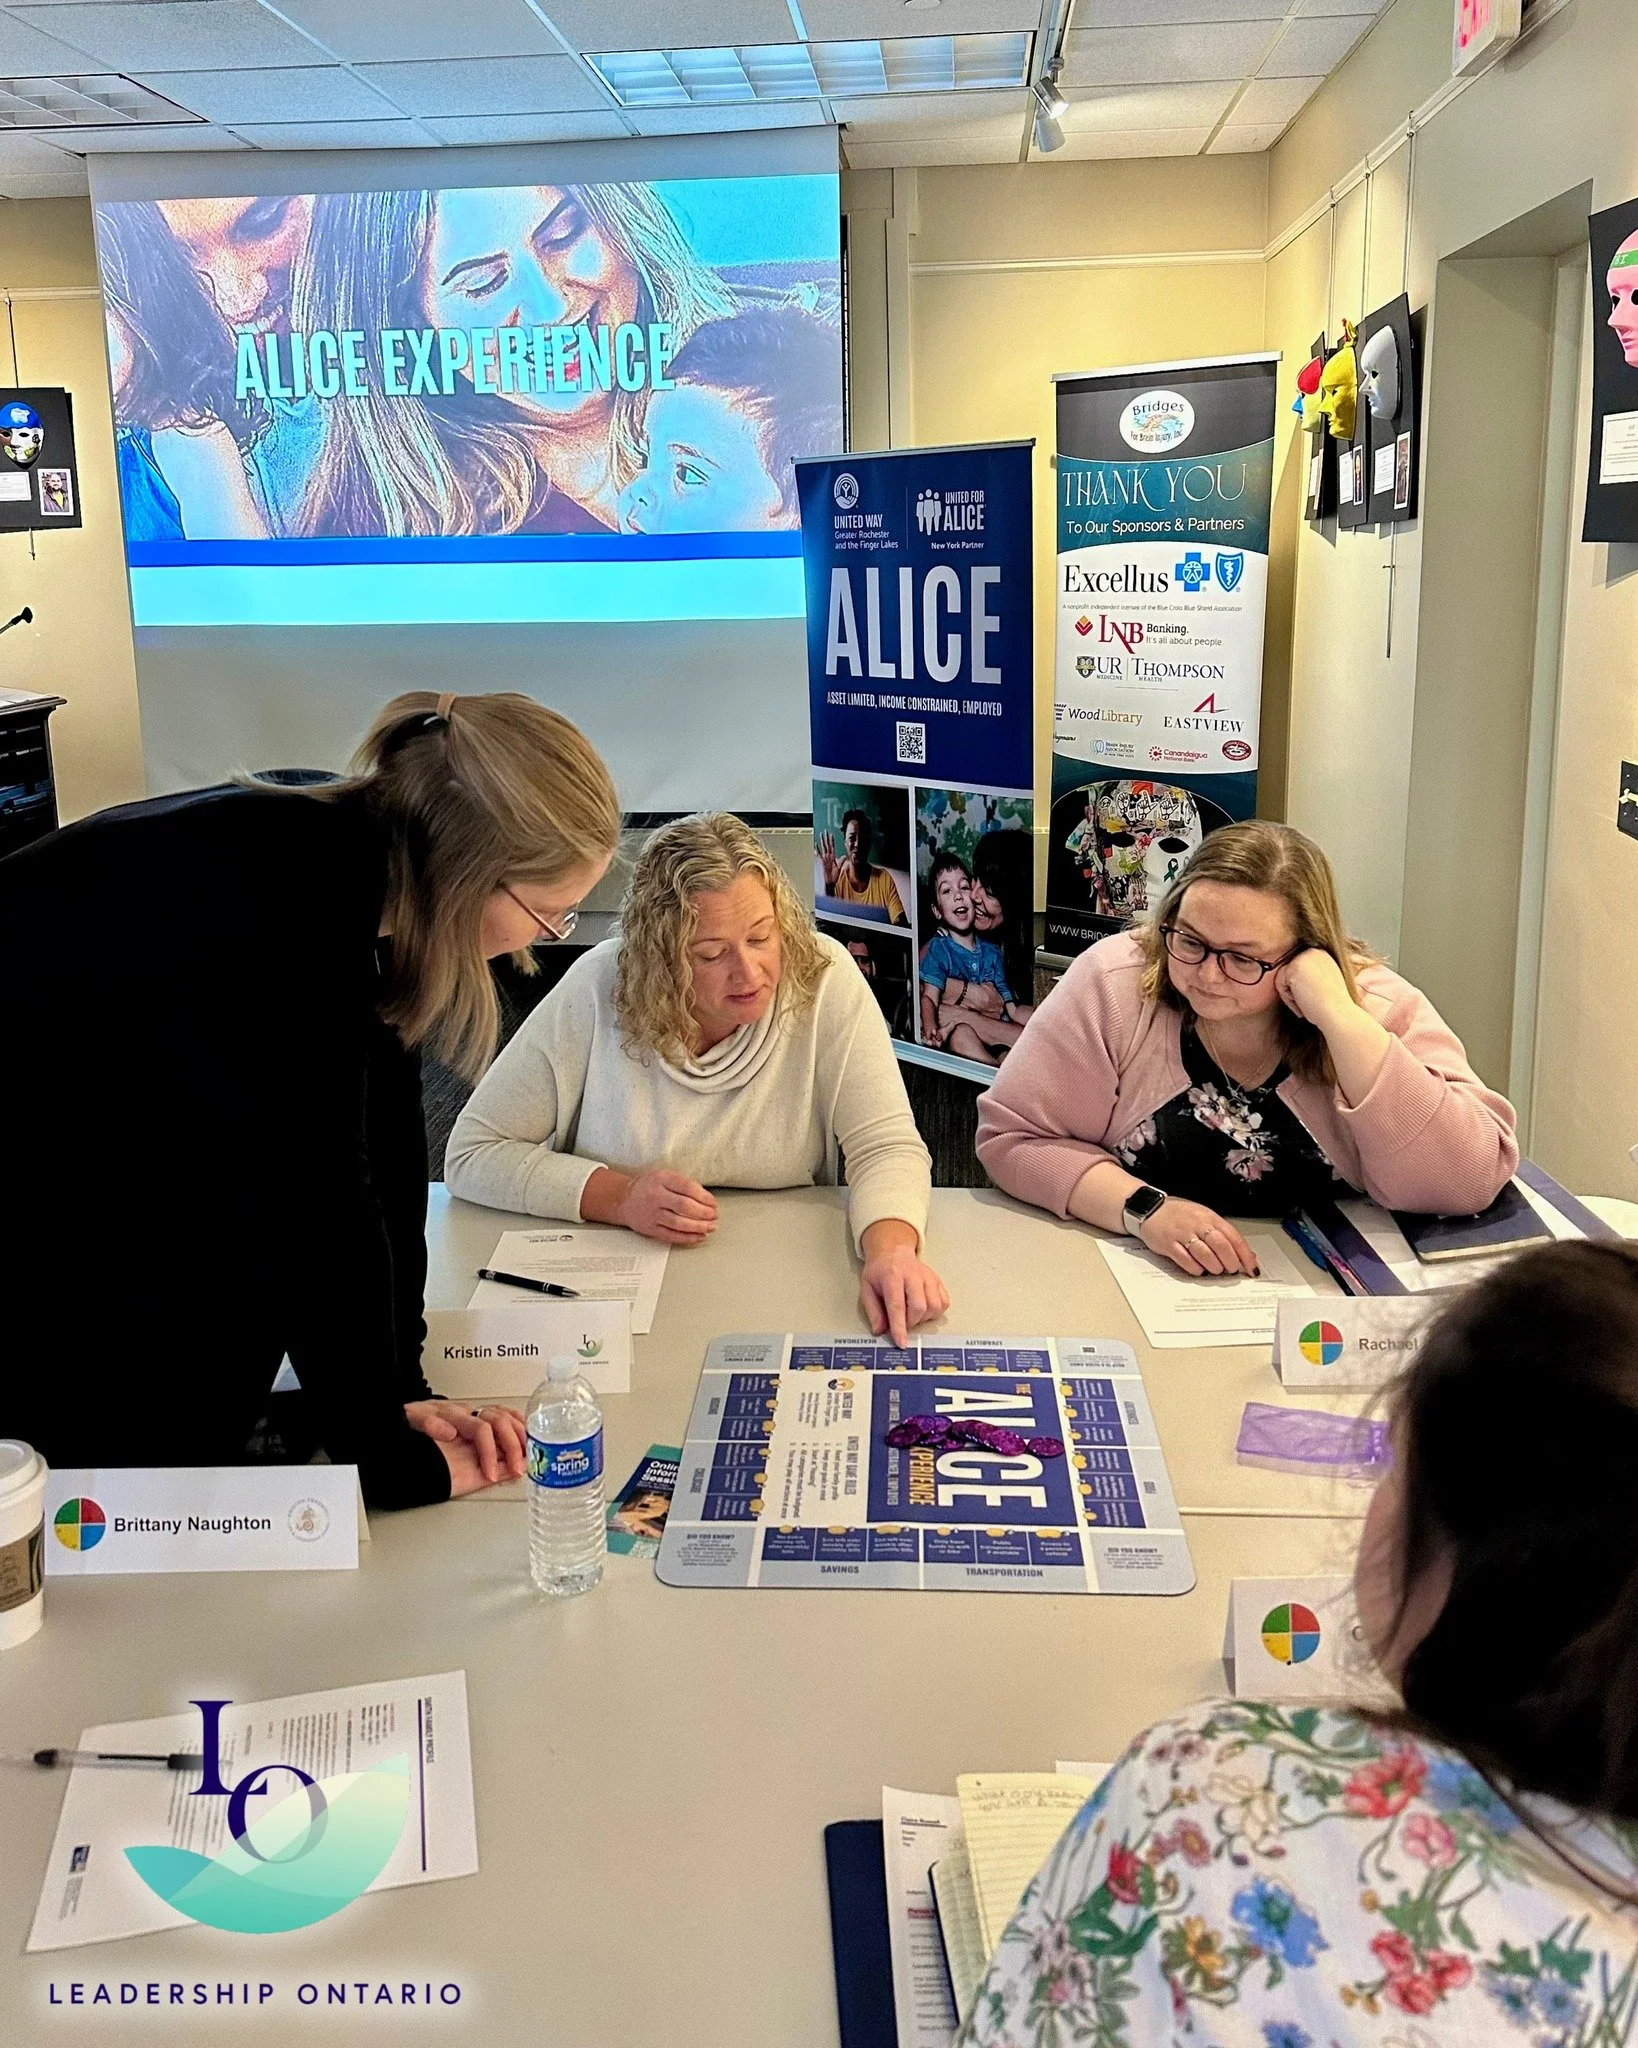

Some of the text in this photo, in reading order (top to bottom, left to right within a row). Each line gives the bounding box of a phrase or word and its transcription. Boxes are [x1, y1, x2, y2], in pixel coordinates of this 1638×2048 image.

[235, 322, 675, 400] ALICE EXPERIENCE
[1132, 400, 1185, 416] Bridges
[1063, 463, 1247, 512] THANK YOU
[945, 490, 984, 504] UNITED FOR
[834, 514, 883, 529] UNITED WAY
[943, 504, 984, 531] ALICE
[1066, 517, 1245, 536] To Our Sponsors & Partners
[834, 530, 889, 539] Greater Rochester
[835, 540, 899, 550] and the Finger Lakes
[1063, 564, 1169, 594] Excellus
[825, 565, 1002, 685] ALICE
[1098, 614, 1144, 654] LNB
[1147, 623, 1189, 636] Banking.
[1158, 636, 1168, 644] all
[1097, 656, 1225, 679] UR THOMPSON
[827, 691, 1002, 716] ASSET LIMITED, INCOME CONSTRAINED, EMPLOYED
[1164, 716, 1245, 733] EASTVIEW
[1164, 749, 1208, 759] Canandaigua
[444, 1343, 539, 1359] Kristin Smith
[934, 1387, 1047, 1508] ALCE
[551, 1457, 589, 1475] spring
[909, 1444, 934, 1505] XPERIENCE
[114, 1516, 271, 1535] Brittany Naughton
[820, 1565, 859, 1574] SAVINGS
[966, 1567, 1044, 1577] TRANSPORTATION
